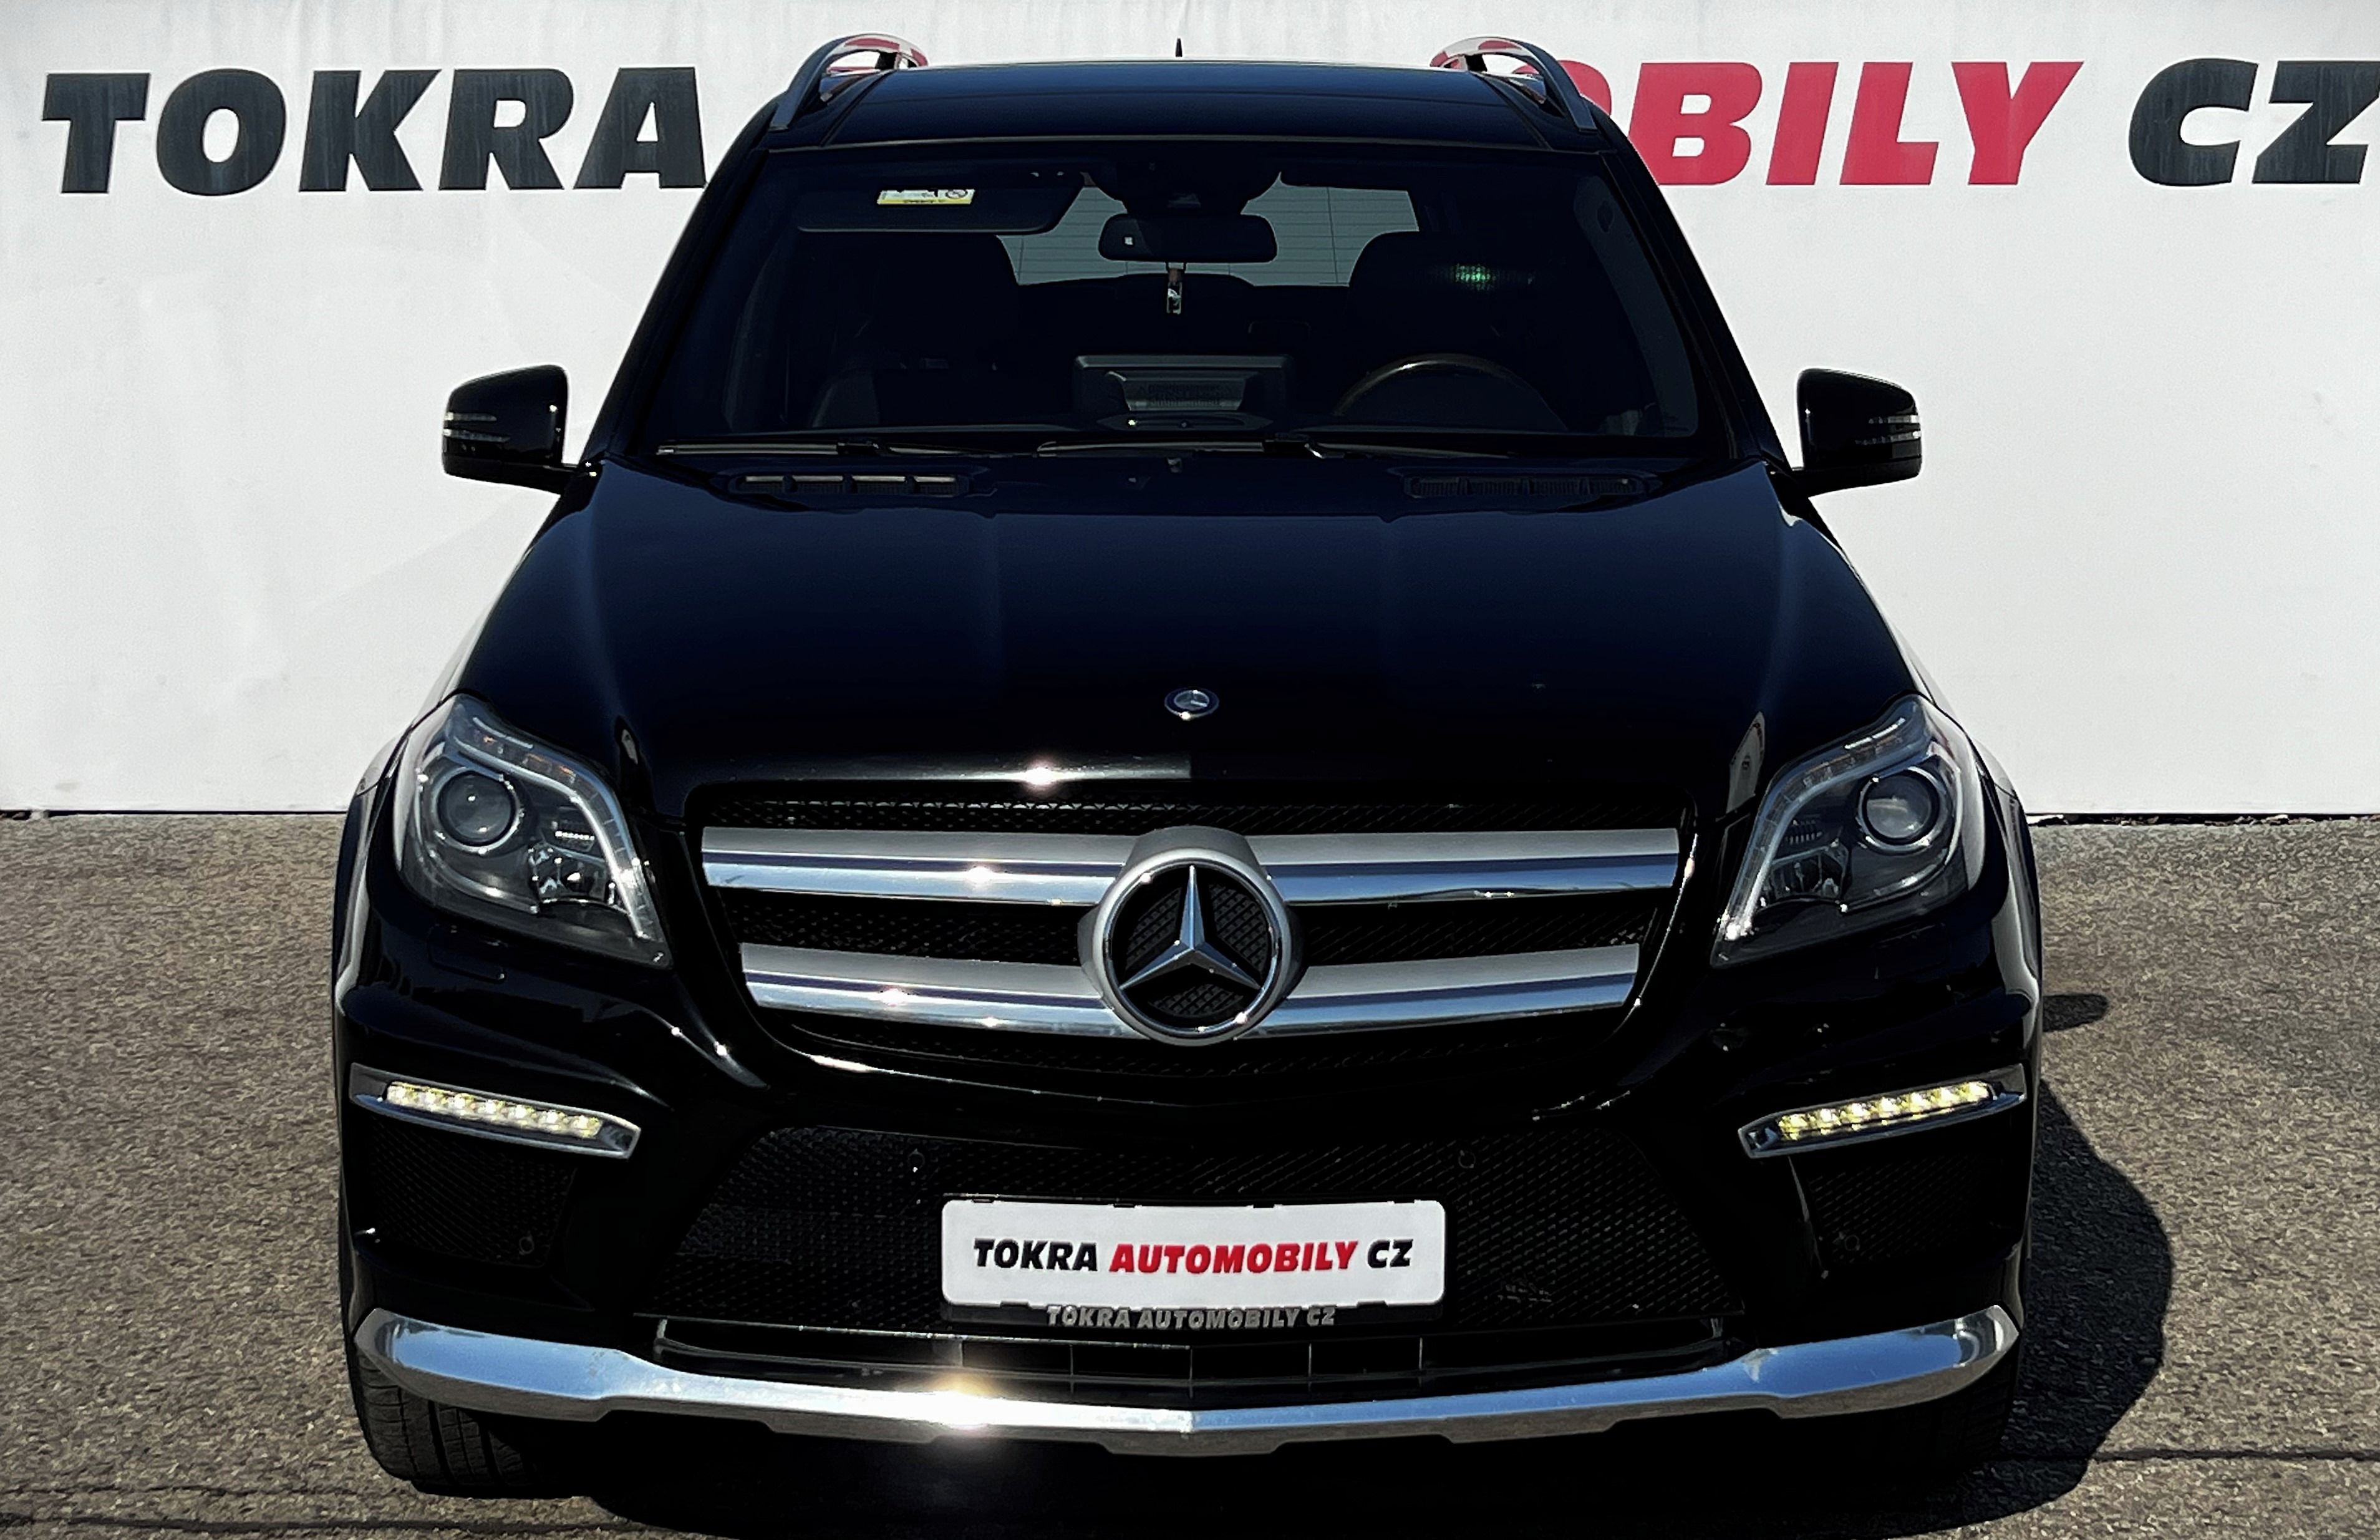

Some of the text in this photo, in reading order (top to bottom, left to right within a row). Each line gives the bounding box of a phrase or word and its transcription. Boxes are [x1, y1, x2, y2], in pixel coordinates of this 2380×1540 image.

[41, 57, 2380, 196] TOKRA BILY CZ
[973, 1237, 1414, 1274] TOKRA AUTOMOBILY CZ
[1046, 1304, 1337, 1330] TOKRA AUTOMOBILY CZ
